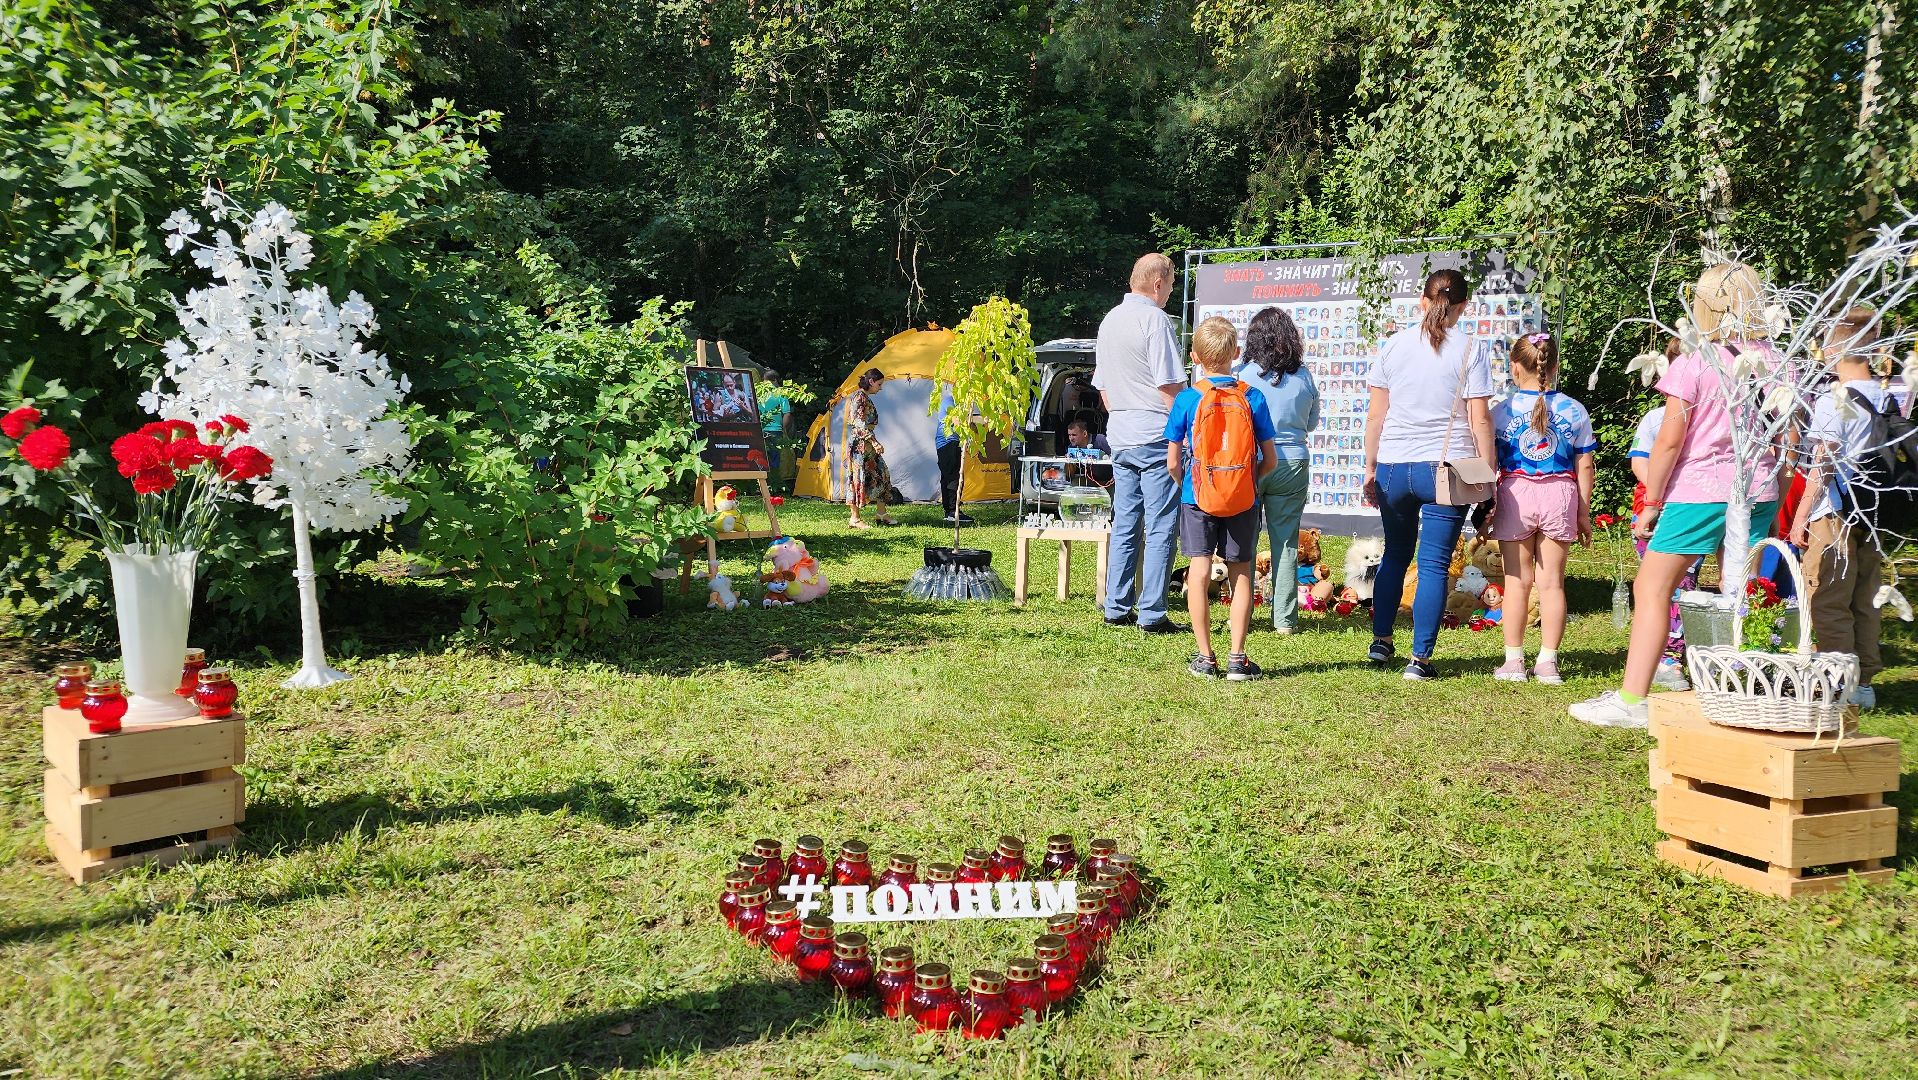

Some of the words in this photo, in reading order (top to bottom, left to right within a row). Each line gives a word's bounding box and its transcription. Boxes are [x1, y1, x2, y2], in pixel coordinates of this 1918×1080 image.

[1224, 267, 1265, 283] ЗНАТЬ
[1274, 264, 1330, 281] ЗНАЧИТ
[1252, 282, 1322, 299] ПОМНИТЬ
